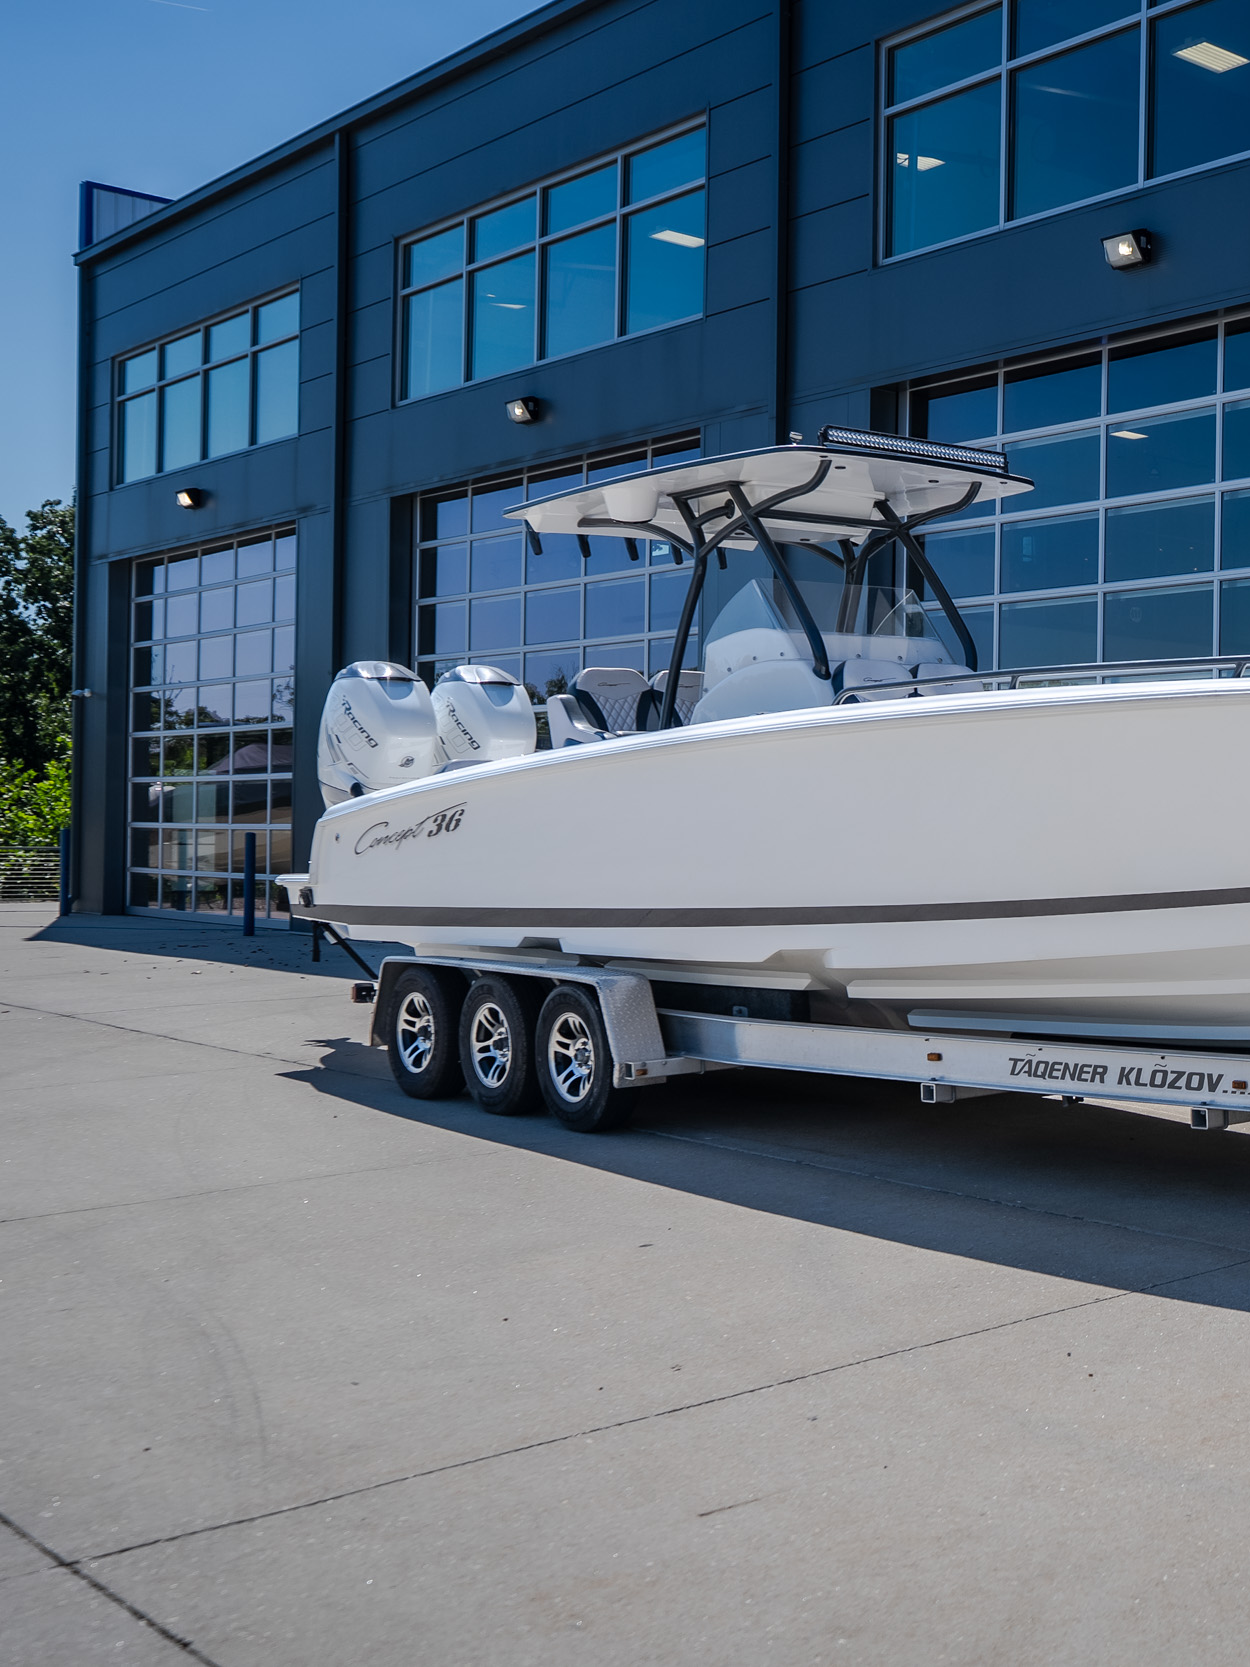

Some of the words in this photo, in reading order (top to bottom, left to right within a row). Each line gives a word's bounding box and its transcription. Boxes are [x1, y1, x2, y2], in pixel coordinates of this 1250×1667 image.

[341, 696, 379, 749] Racing
[446, 699, 481, 751] Racing
[427, 808, 465, 838] 36
